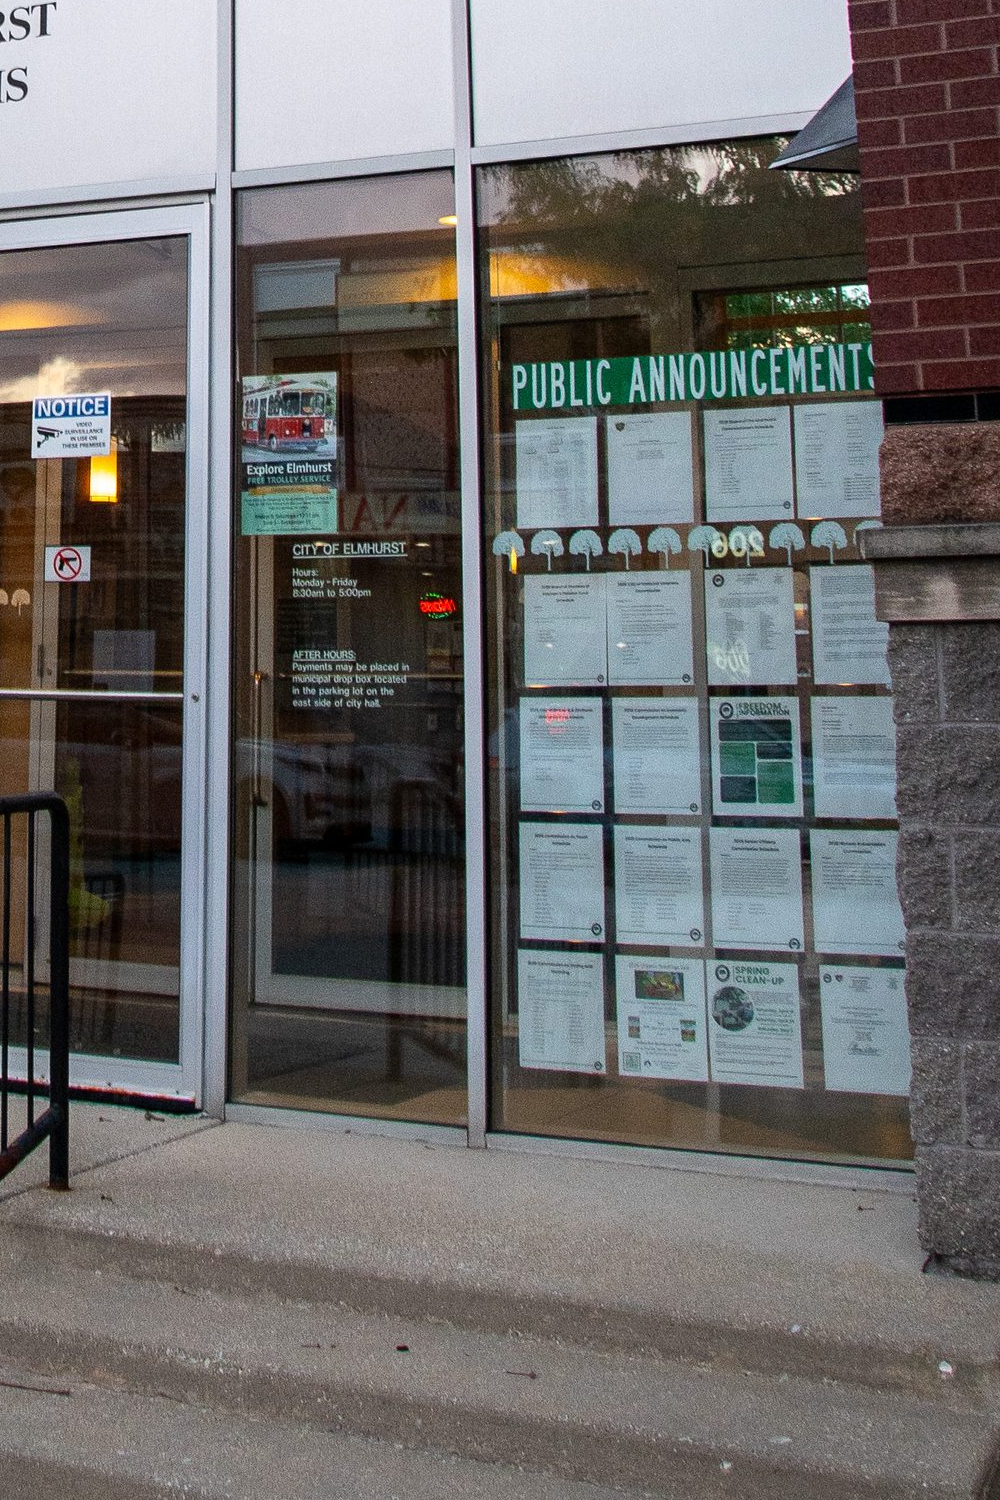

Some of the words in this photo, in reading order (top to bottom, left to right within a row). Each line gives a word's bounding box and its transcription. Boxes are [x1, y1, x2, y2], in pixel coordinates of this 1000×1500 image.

[513, 359, 612, 410] PUBLIC
[37, 397, 105, 417] NOTICE
[247, 464, 284, 476] Explore
[287, 462, 332, 474] Elmhurst
[267, 476, 300, 484] TROLLEY
[293, 544, 318, 555] CITY
[323, 543, 340, 555] OF
[343, 542, 407, 554] ELMHURST
[292, 568, 319, 576] Hours:
[292, 578, 325, 588] Monday
[332, 578, 358, 587] Friday
[292, 589, 324, 598] 8:30am
[327, 588, 335, 597] to
[338, 588, 371, 598] 5:00pm
[293, 650, 321, 659] AFTER
[323, 650, 356, 659] HOURS:
[292, 663, 333, 672] Payments
[335, 664, 353, 672] may
[356, 663, 367, 671] be
[370, 663, 399, 672] placed
[401, 663, 410, 671] in
[292, 675, 331, 684] municipal
[333, 675, 352, 684] drop
[355, 675, 371, 683] box
[374, 675, 407, 683] located
[292, 687, 300, 695] in
[303, 687, 316, 695] the
[319, 686, 350, 697] parking
[352, 687, 363, 695] lot
[380, 687, 394, 695] the
[292, 699, 311, 707] east
[314, 699, 331, 707] side
[334, 699, 344, 707] of
[346, 699, 362, 709] city
[735, 966, 770, 975] SPRING
[735, 975, 784, 985] CLEAN-UP
